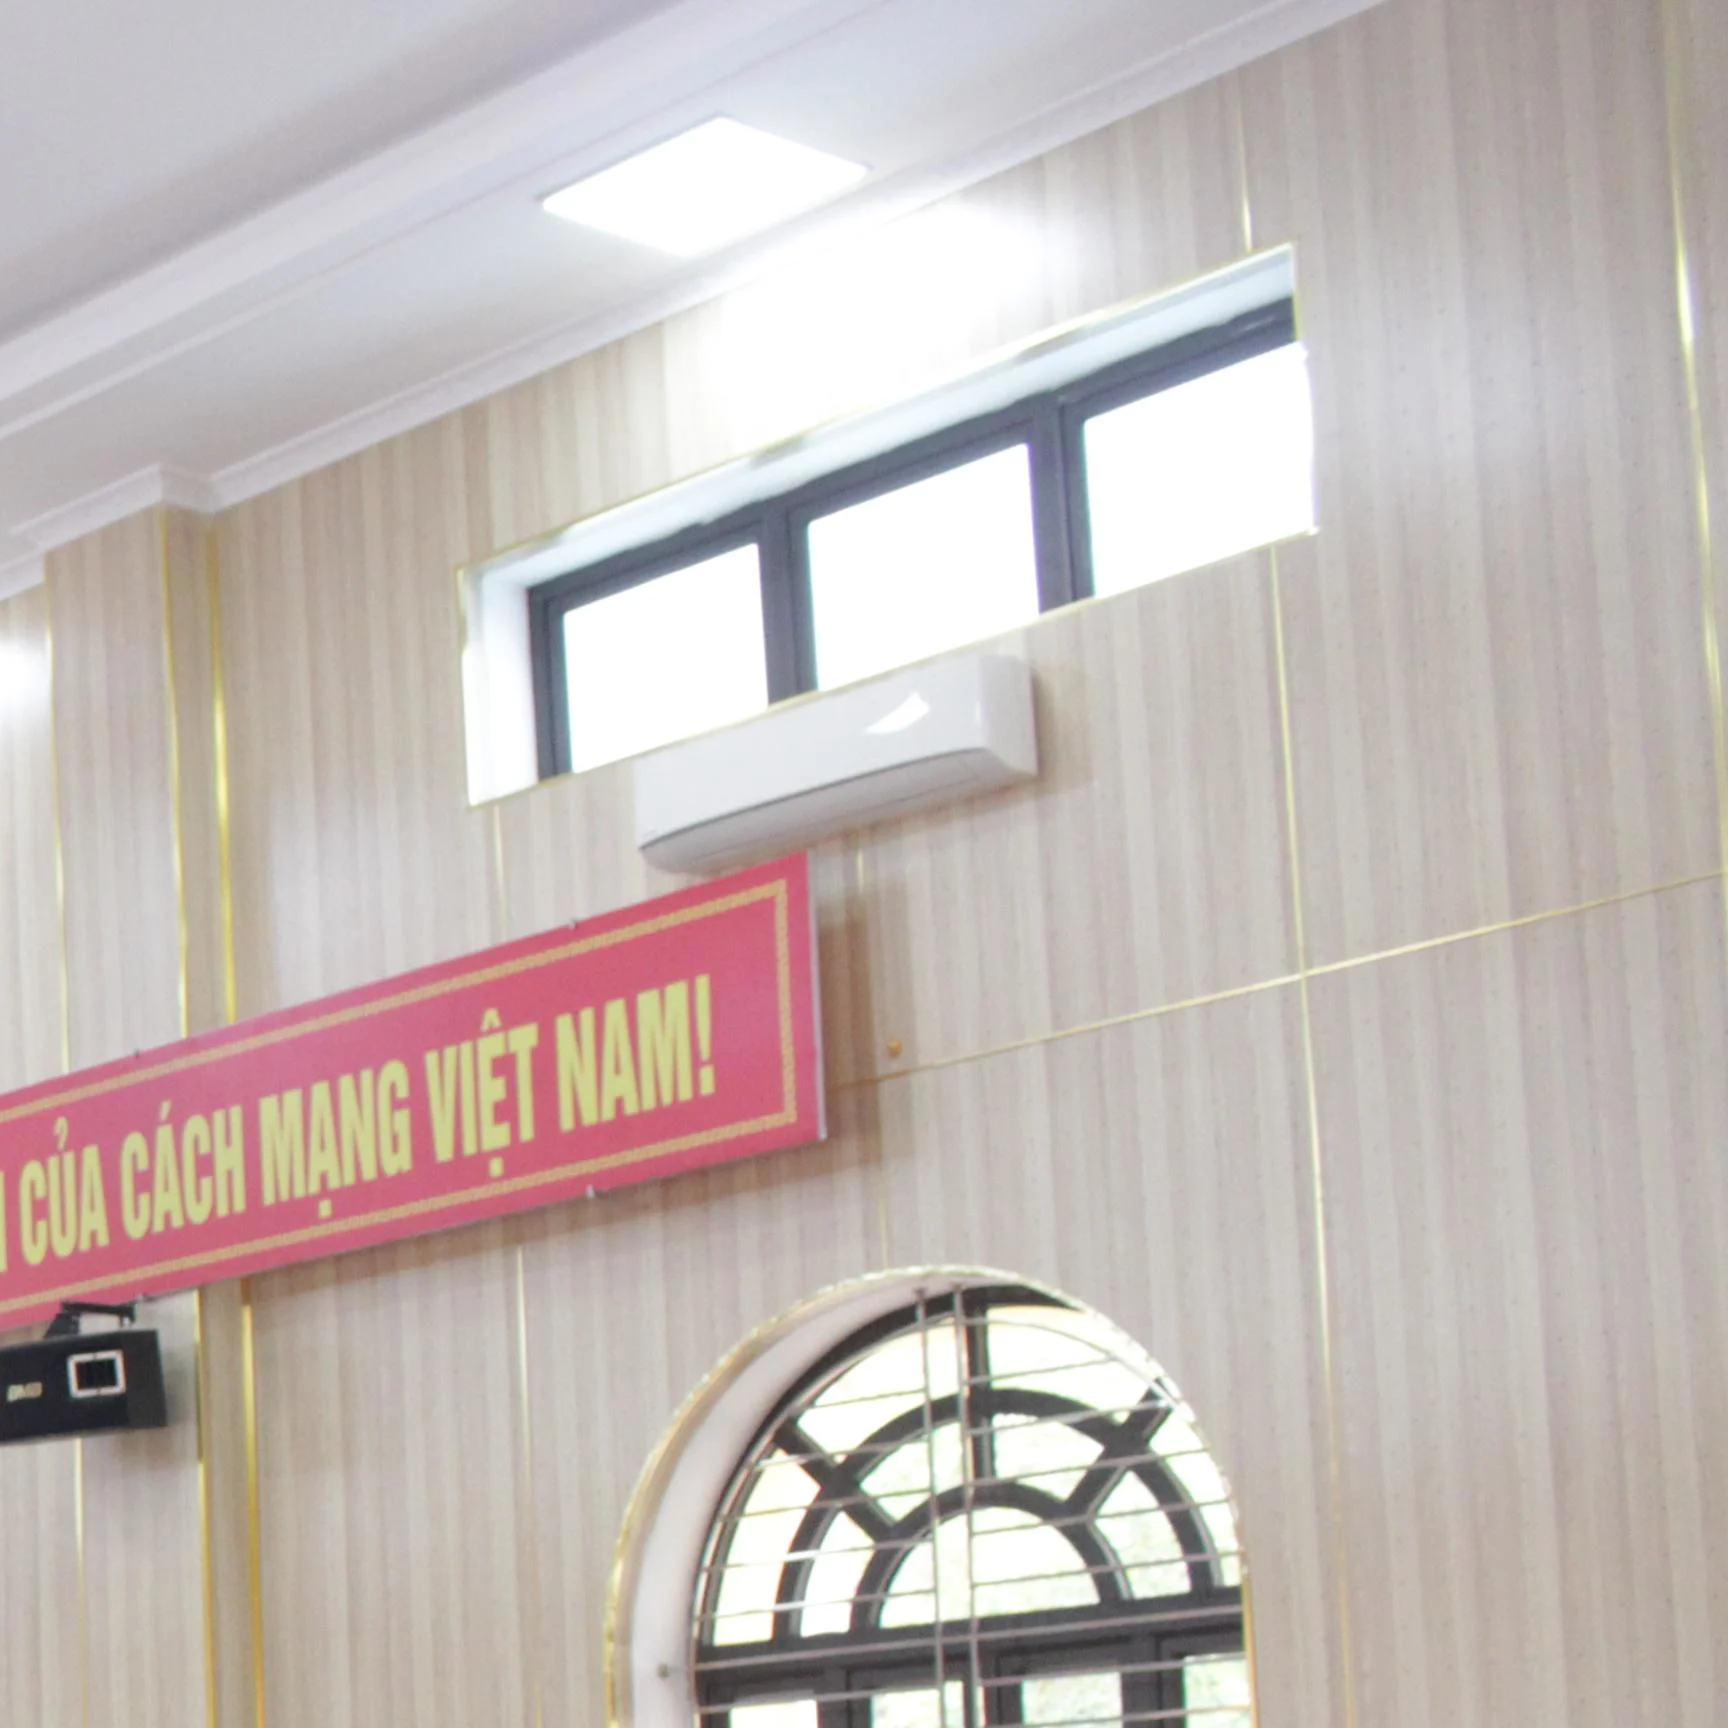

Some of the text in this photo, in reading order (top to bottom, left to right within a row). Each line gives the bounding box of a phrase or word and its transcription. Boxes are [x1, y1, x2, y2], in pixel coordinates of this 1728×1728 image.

[20, 1116, 108, 1266] CỦA
[120, 1101, 245, 1239] CÁCH
[260, 1059, 412, 1219] MẠNG
[425, 1007, 538, 1178] VIỆT
[555, 974, 715, 1133] NAM!
